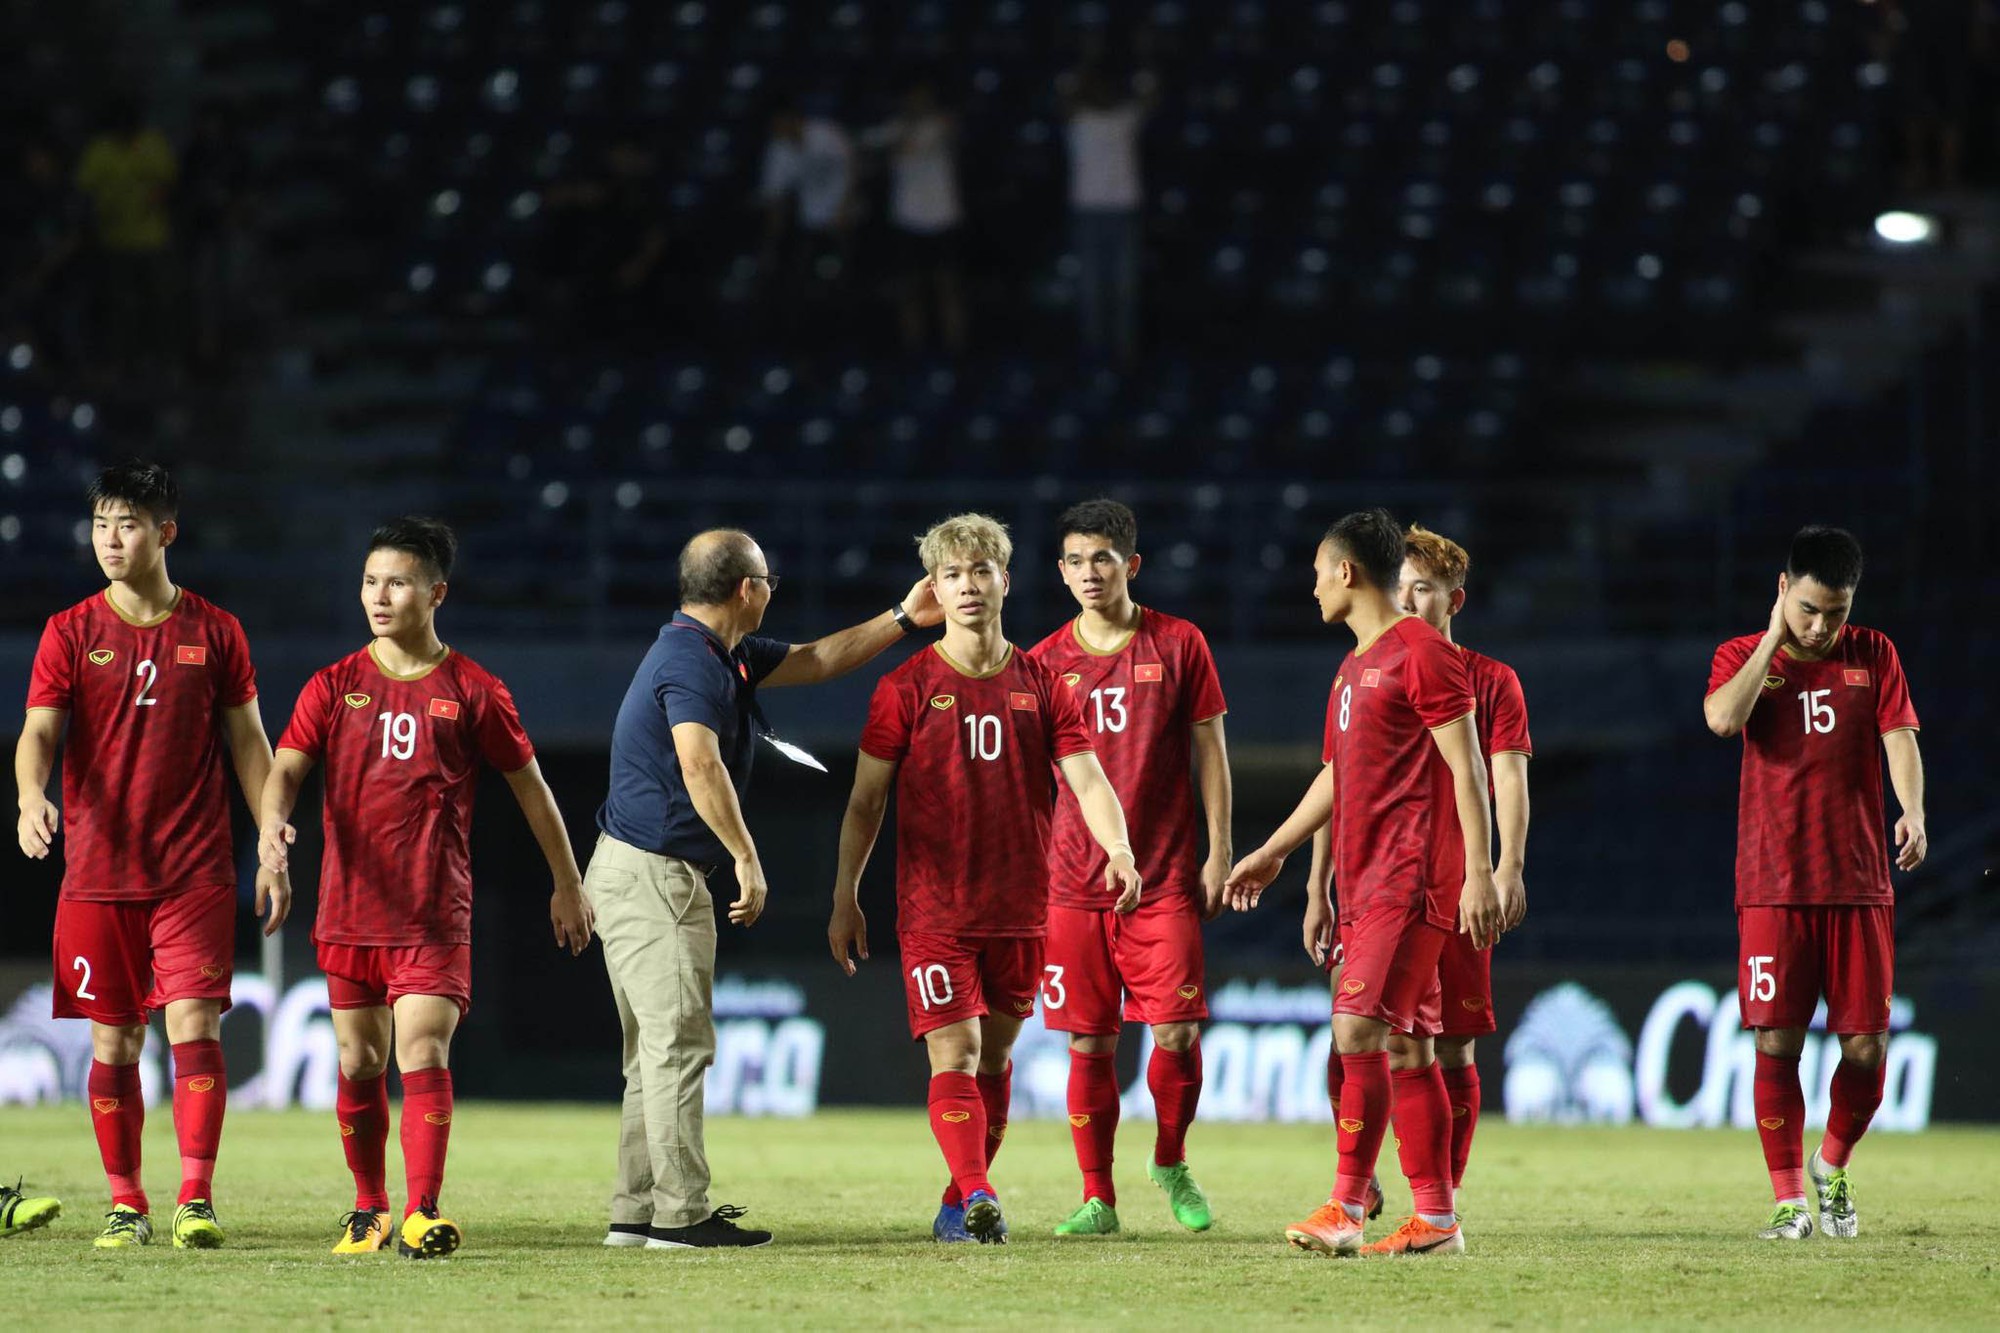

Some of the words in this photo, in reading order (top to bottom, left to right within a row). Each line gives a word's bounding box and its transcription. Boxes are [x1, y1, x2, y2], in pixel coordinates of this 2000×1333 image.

[134, 658, 157, 706] 2
[1089, 685, 1128, 734] 13
[1338, 683, 1354, 733] 8
[1797, 688, 1836, 735] 15
[378, 711, 417, 761] 19
[964, 714, 1002, 761] 10
[73, 955, 96, 1001] 2
[911, 963, 954, 1011] 10
[1041, 964, 1066, 1010] 3
[1747, 955, 1777, 1002] 15
